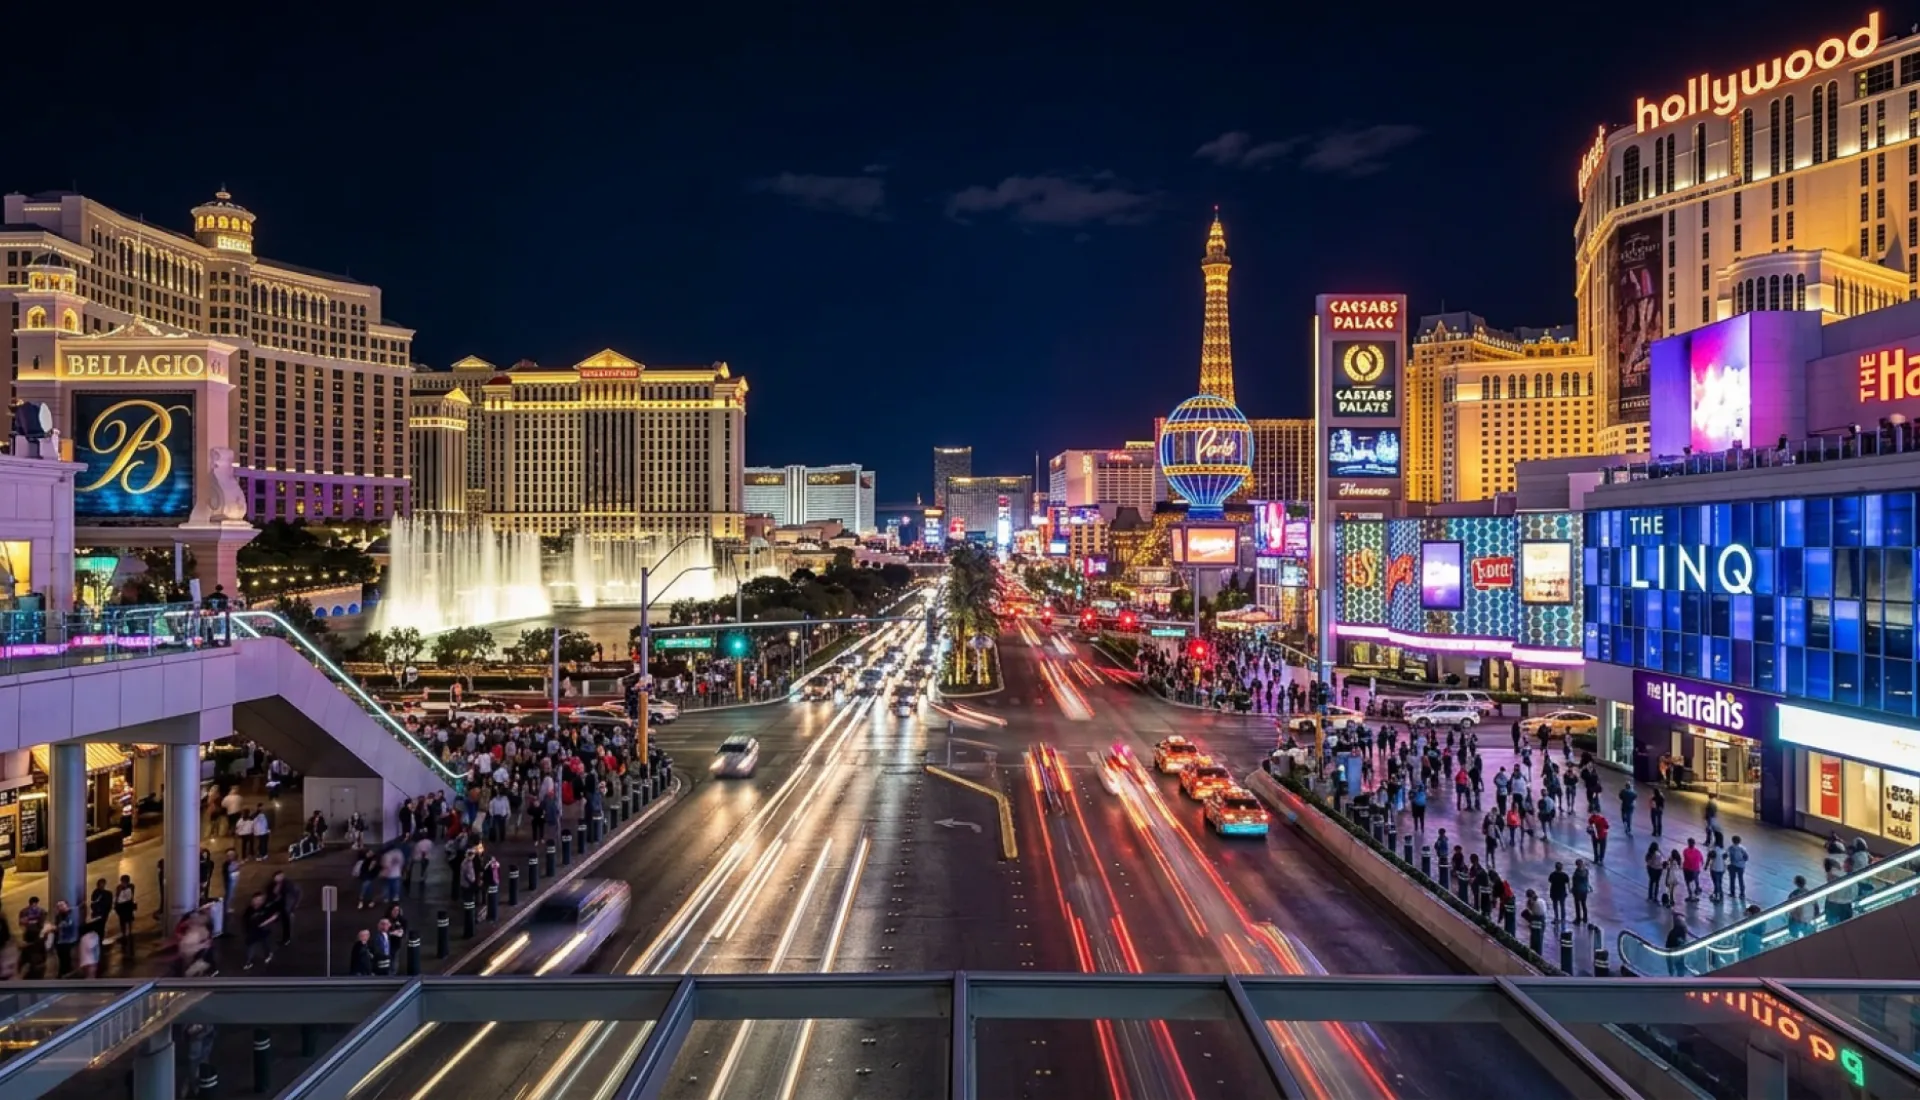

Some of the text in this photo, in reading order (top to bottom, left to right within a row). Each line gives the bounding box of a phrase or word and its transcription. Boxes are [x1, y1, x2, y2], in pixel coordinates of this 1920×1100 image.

[1636, 10, 1880, 134] hollywood
[67, 354, 205, 376] BELLAGIO
[1860, 353, 1877, 403] THE
[1629, 516, 1664, 536] THE
[1630, 543, 1753, 595] LINQ
[1662, 681, 1744, 730] Harrah's
